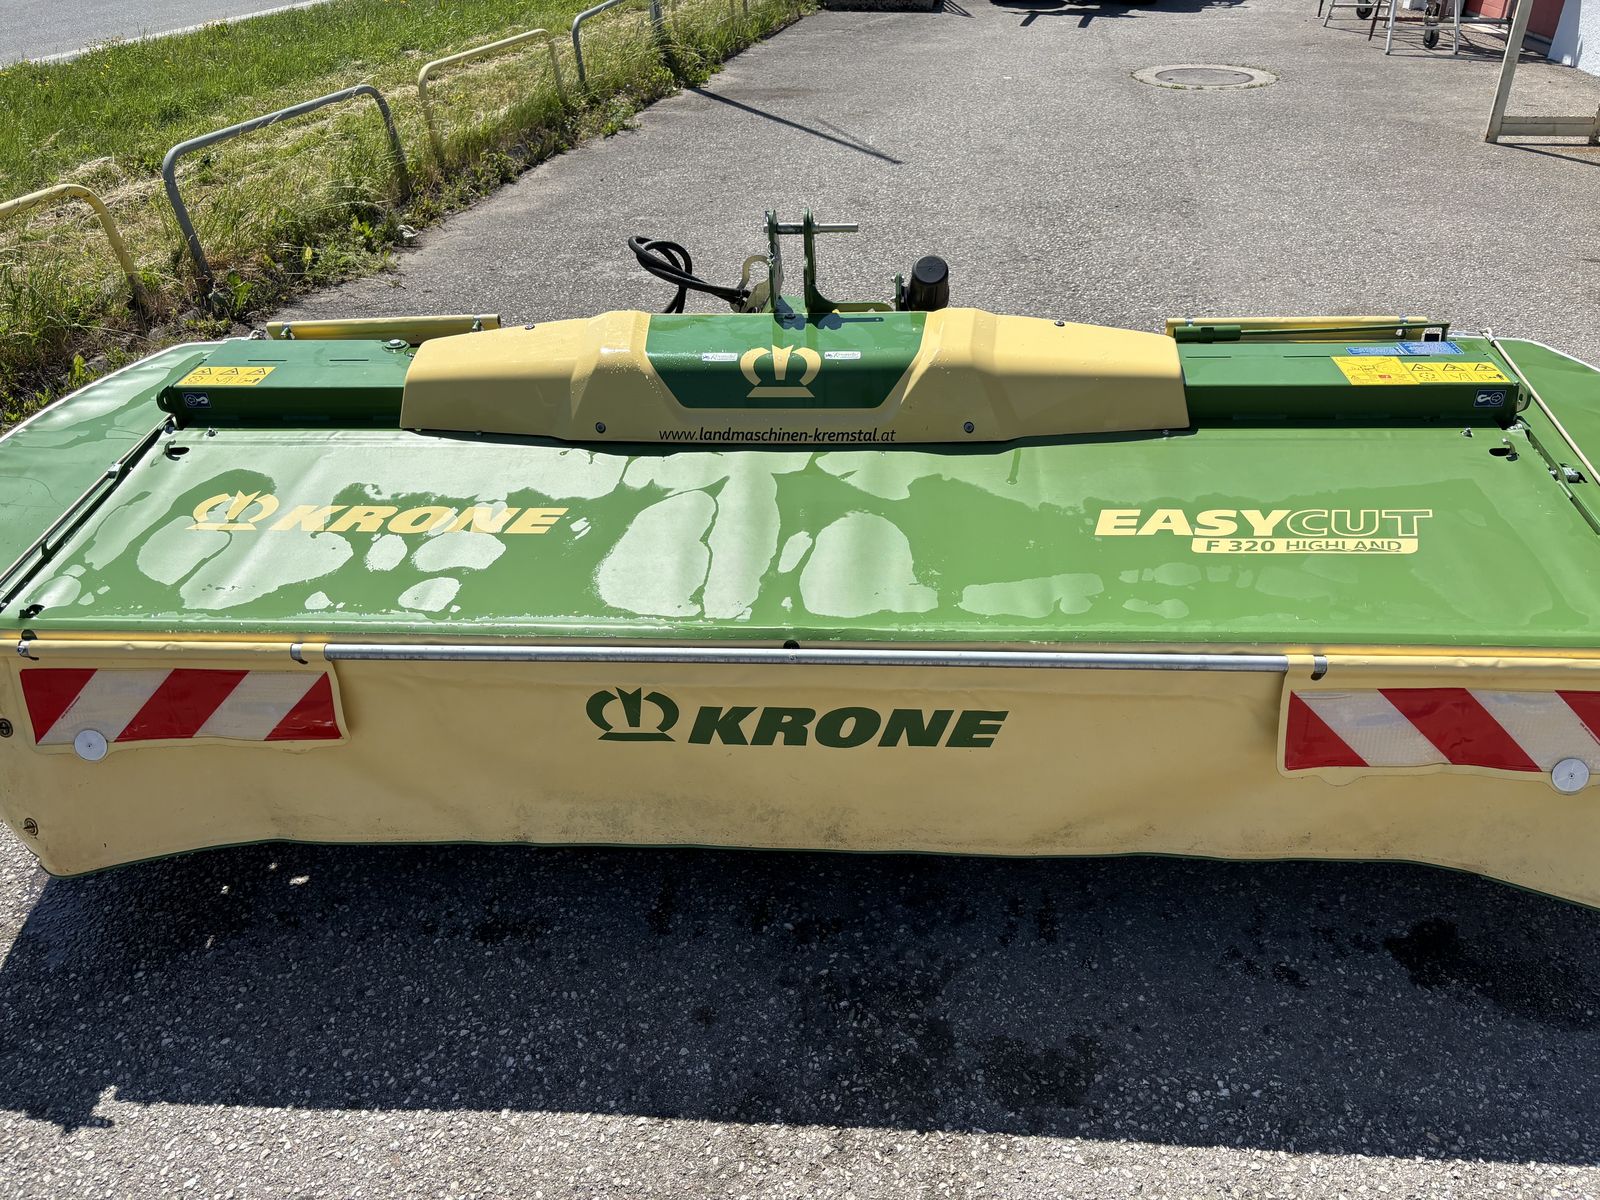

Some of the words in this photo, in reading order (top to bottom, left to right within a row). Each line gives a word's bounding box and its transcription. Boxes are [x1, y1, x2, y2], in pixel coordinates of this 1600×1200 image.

[659, 427, 896, 442] www.landmaschinen-kremstal.at
[269, 505, 569, 535] KRONE
[1094, 508, 1433, 537] EASYCUT
[1206, 540, 1221, 552] F
[1228, 540, 1276, 552] 320
[1285, 540, 1402, 552] HIGHLAND
[687, 706, 1009, 748] KRONE
